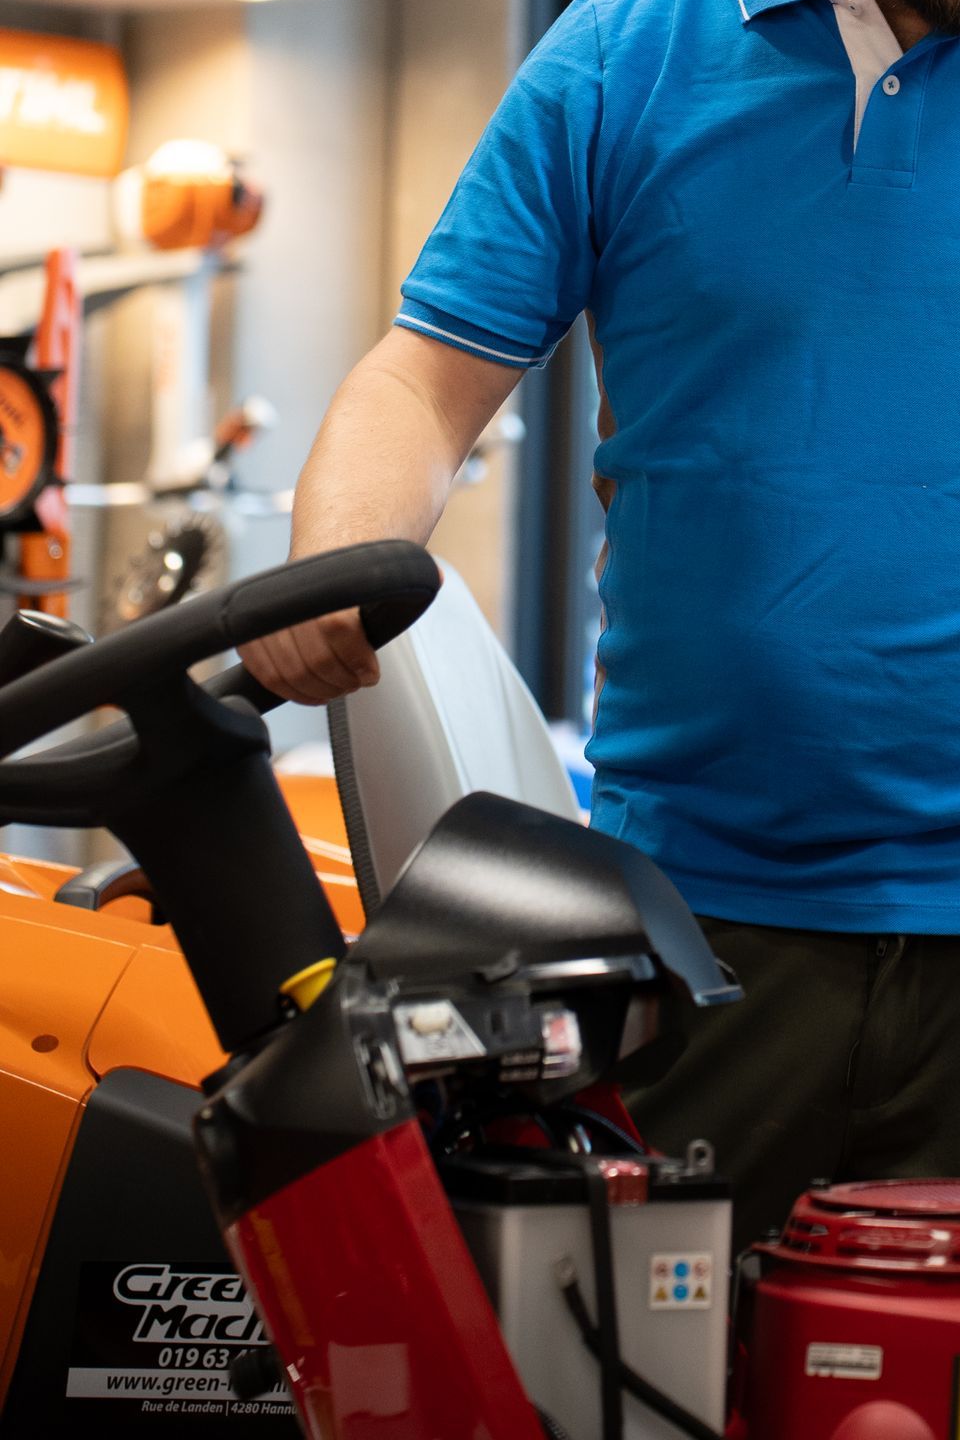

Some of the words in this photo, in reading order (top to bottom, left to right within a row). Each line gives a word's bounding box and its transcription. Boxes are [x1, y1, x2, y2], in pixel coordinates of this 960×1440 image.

[158, 1348, 199, 1368] 019
[203, 1348, 229, 1368] 63
[141, 1401, 163, 1412] Rue
[165, 1401, 178, 1413] de
[181, 1401, 223, 1414] Landen
[231, 1402, 259, 1415] 4280
